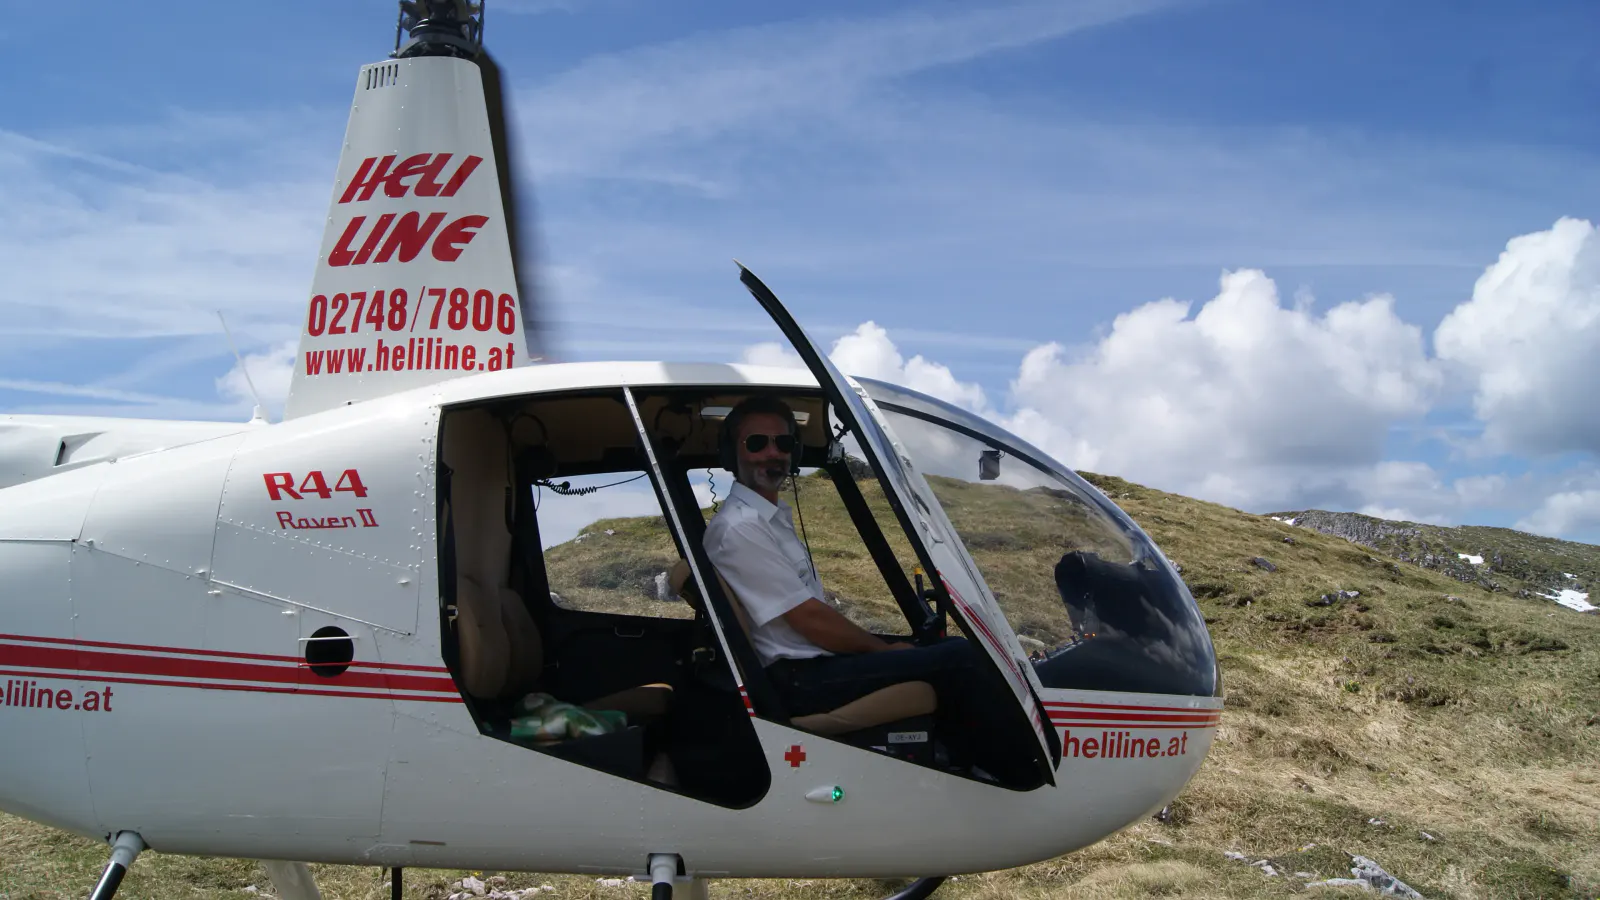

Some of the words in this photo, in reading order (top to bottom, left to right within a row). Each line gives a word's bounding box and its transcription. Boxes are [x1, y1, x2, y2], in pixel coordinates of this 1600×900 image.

[338, 153, 483, 204] HELI
[328, 211, 489, 267] LINE
[308, 286, 515, 336] 02748/7806
[306, 337, 515, 375] www.heliline.at
[263, 469, 368, 500] R44
[276, 511, 357, 529] Raven
[0, 680, 113, 712] liline.at
[1062, 730, 1187, 758] heliline.at
